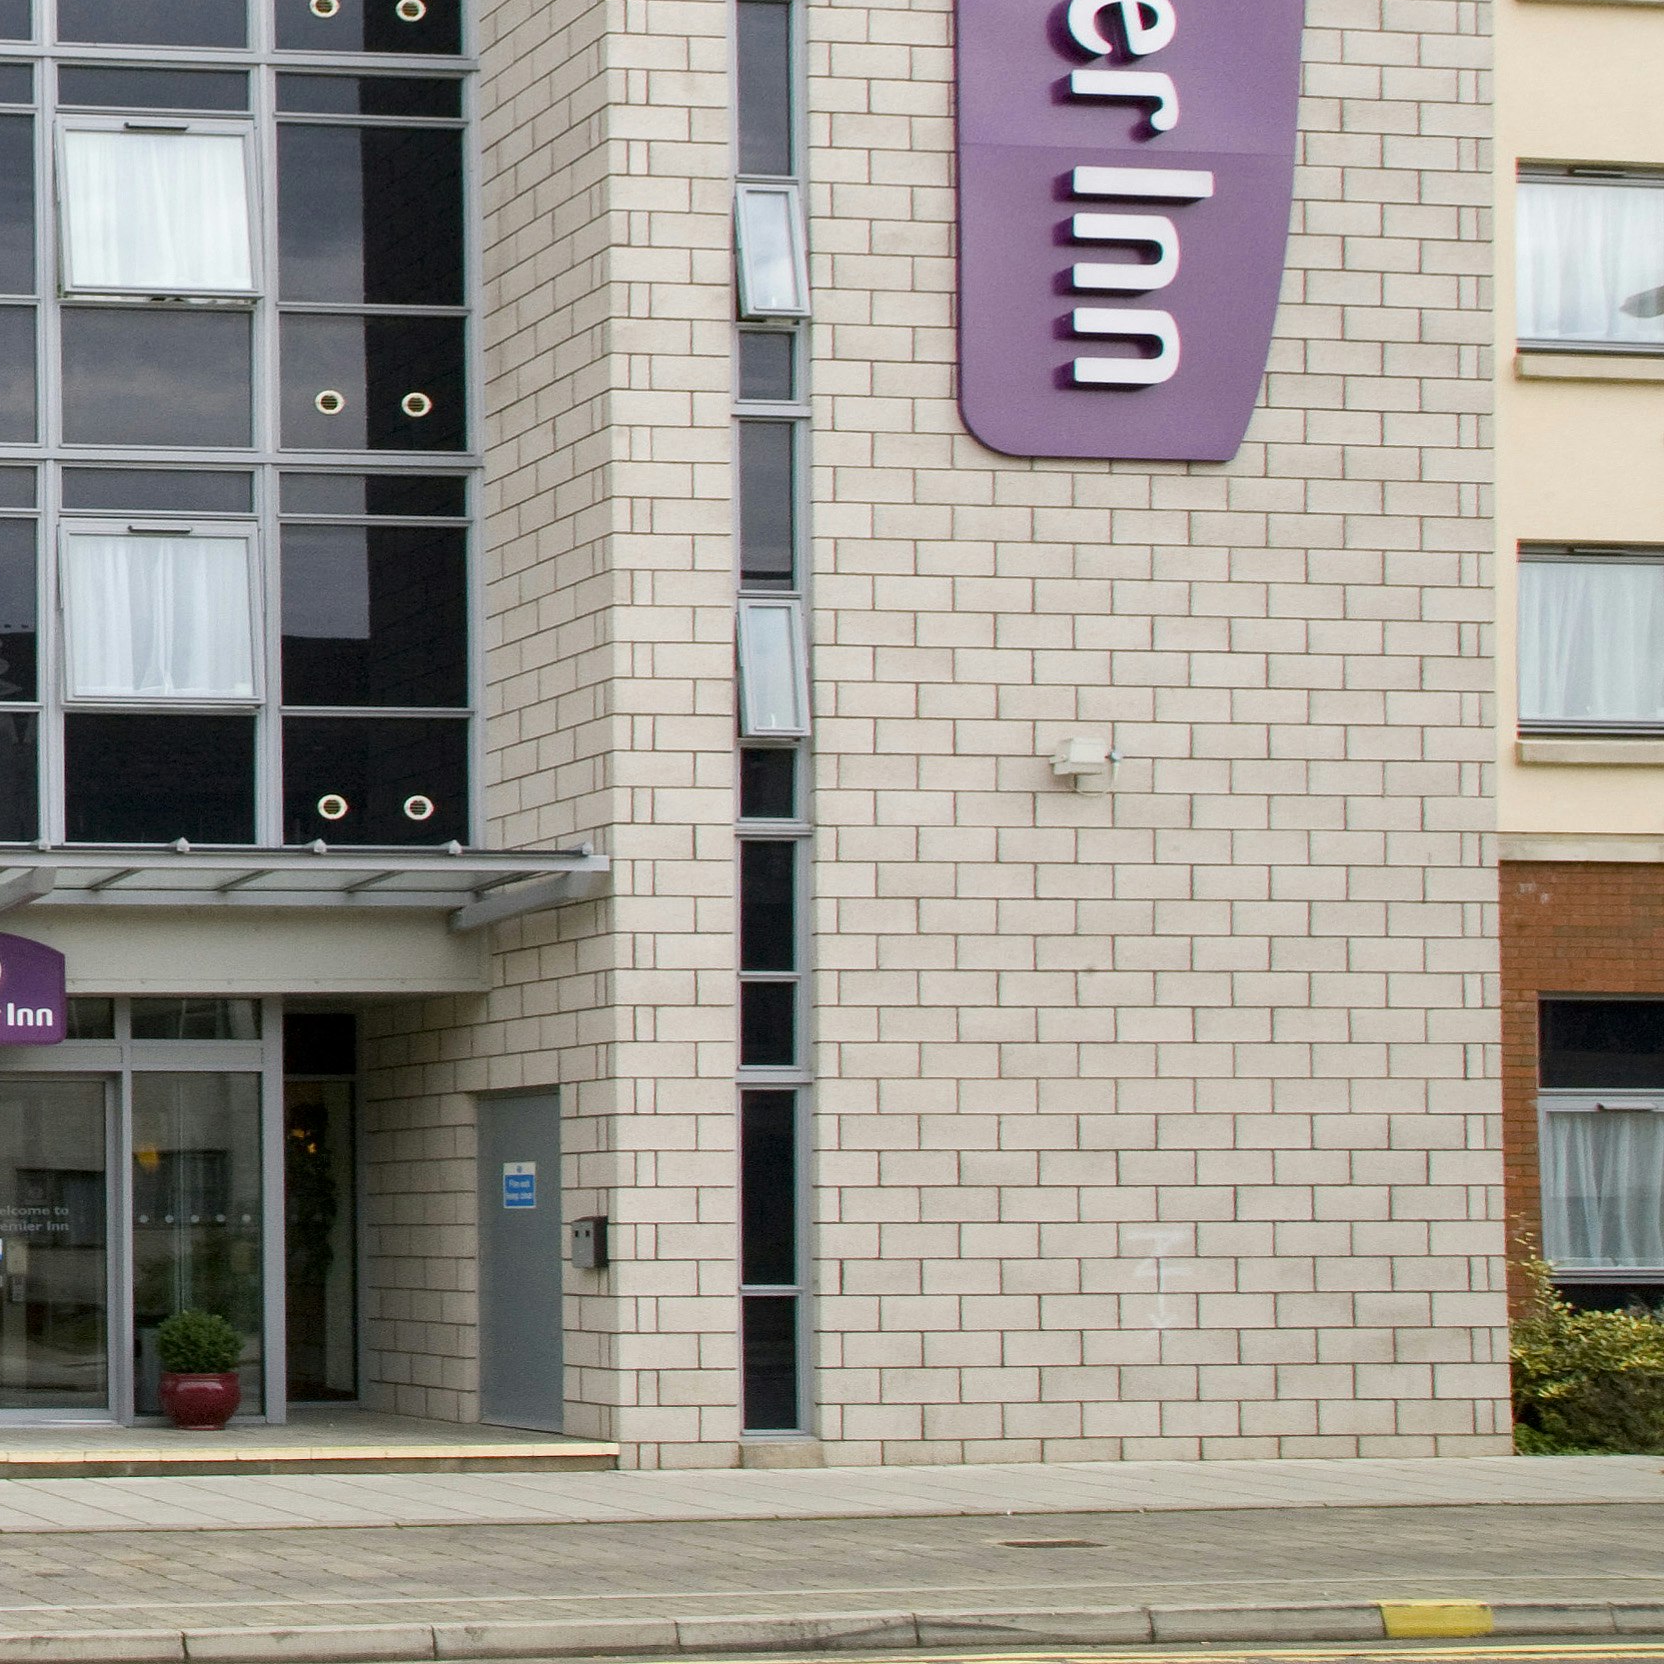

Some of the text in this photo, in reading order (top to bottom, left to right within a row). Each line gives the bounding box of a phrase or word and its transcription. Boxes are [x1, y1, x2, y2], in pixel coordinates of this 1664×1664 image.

[1073, 165, 1214, 384] Inn
[7, 1002, 53, 1026] Inn
[54, 1205, 69, 1215] to
[47, 1221, 70, 1231] Inn
